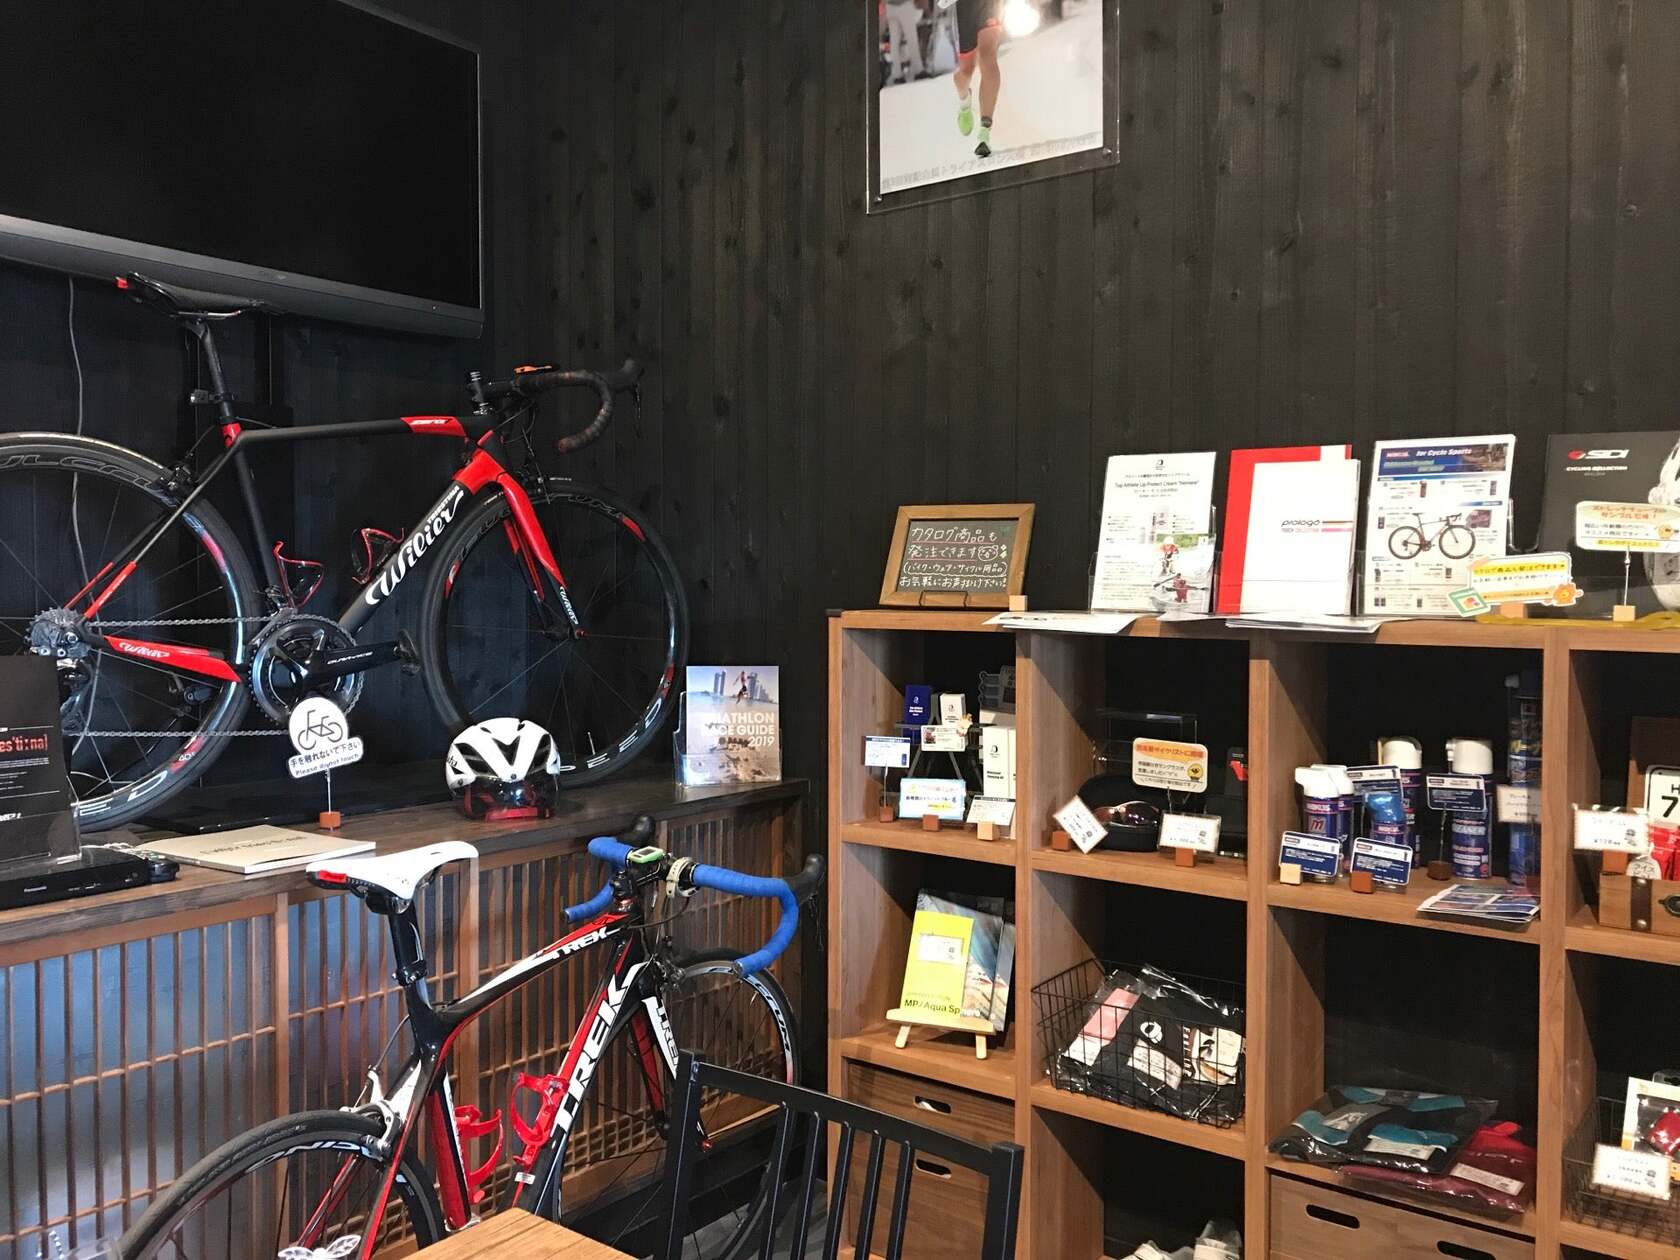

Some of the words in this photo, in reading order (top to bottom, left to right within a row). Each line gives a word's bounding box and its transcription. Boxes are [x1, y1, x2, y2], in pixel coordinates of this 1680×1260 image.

[365, 489, 465, 606] Wilier
[705, 711, 775, 724] ATHLON
[736, 724, 775, 736] GUIDE
[748, 736, 775, 748] 2019
[290, 740, 361, 768] 手を触れないで下さい
[295, 766, 318, 776] Please
[340, 753, 359, 763] touch
[1661, 795, 1679, 818] 7
[547, 927, 608, 961] TREK
[550, 962, 651, 1138] TREK
